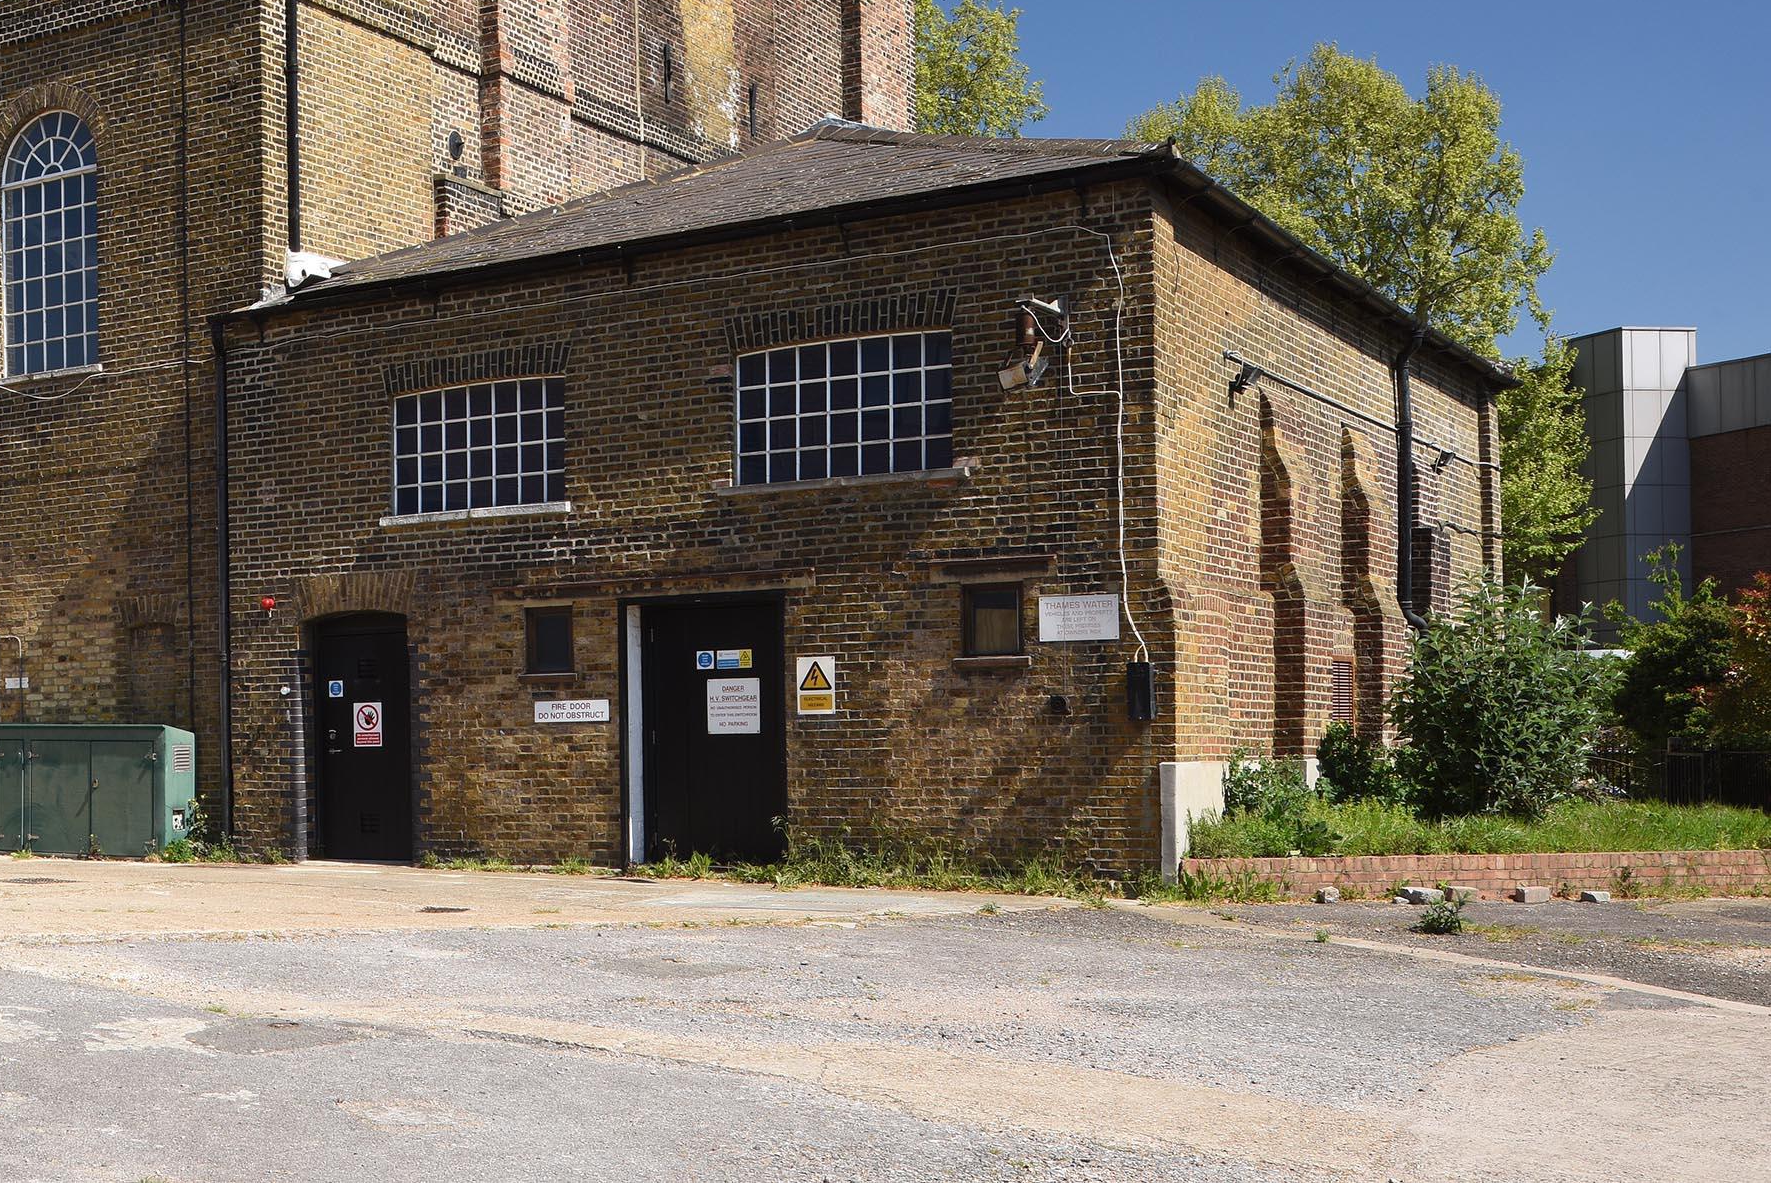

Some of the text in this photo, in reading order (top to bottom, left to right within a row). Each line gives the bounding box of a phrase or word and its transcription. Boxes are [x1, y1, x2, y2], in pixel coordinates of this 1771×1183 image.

[1044, 600, 1113, 609] THAMES WATER
[569, 702, 591, 710] DOOR
[538, 712, 549, 720] DO
[565, 711, 605, 719] OBSTRUCT
